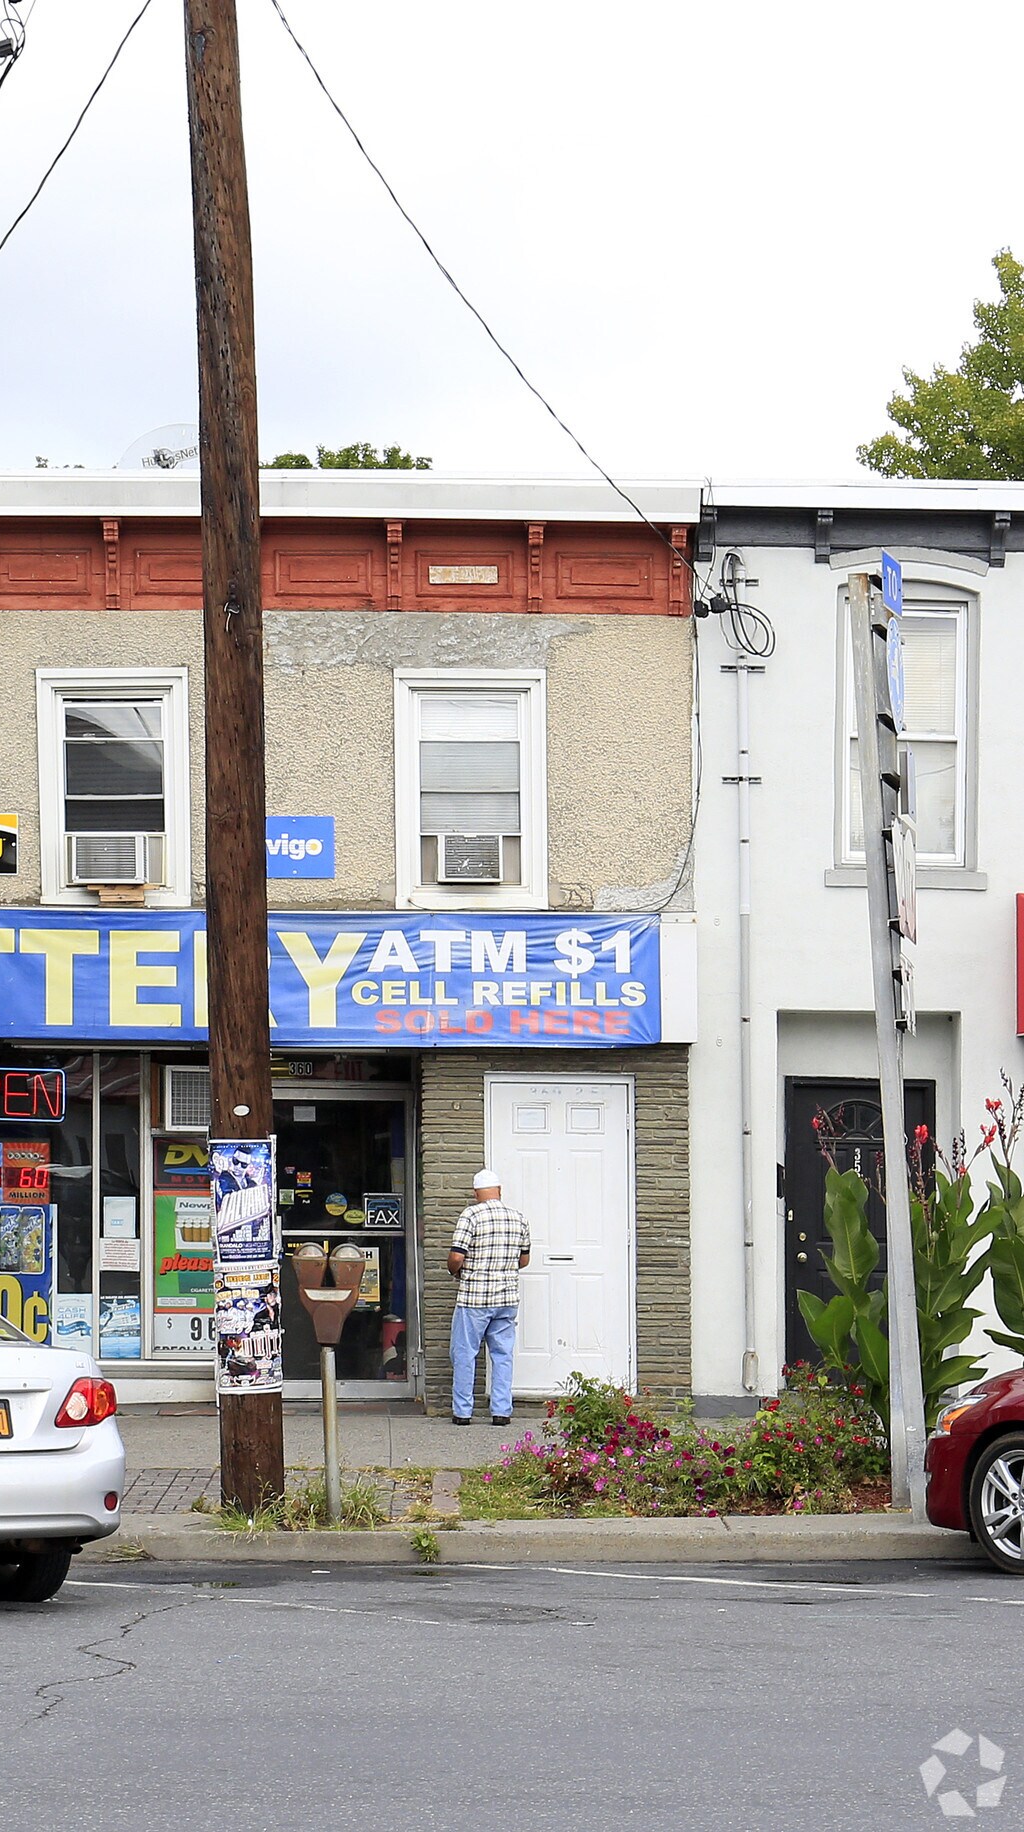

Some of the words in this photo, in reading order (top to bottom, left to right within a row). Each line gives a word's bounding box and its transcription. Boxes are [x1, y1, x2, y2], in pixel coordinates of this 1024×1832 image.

[887, 565, 898, 601] TO
[366, 929, 526, 974] ATM
[554, 928, 632, 979] $1
[351, 981, 459, 1007] CELL
[473, 980, 647, 1007] REFILLS
[376, 1010, 494, 1035] SOLD
[510, 1010, 631, 1035] HERE
[289, 1062, 312, 1075] 360
[164, 1144, 209, 1167] DV
[20, 1167, 48, 1188] 60
[171, 1175, 206, 1183] MOV
[179, 1201, 211, 1210] Newp
[367, 1210, 400, 1224] FAX
[159, 1253, 214, 1275] pleas
[167, 1317, 173, 1329] $
